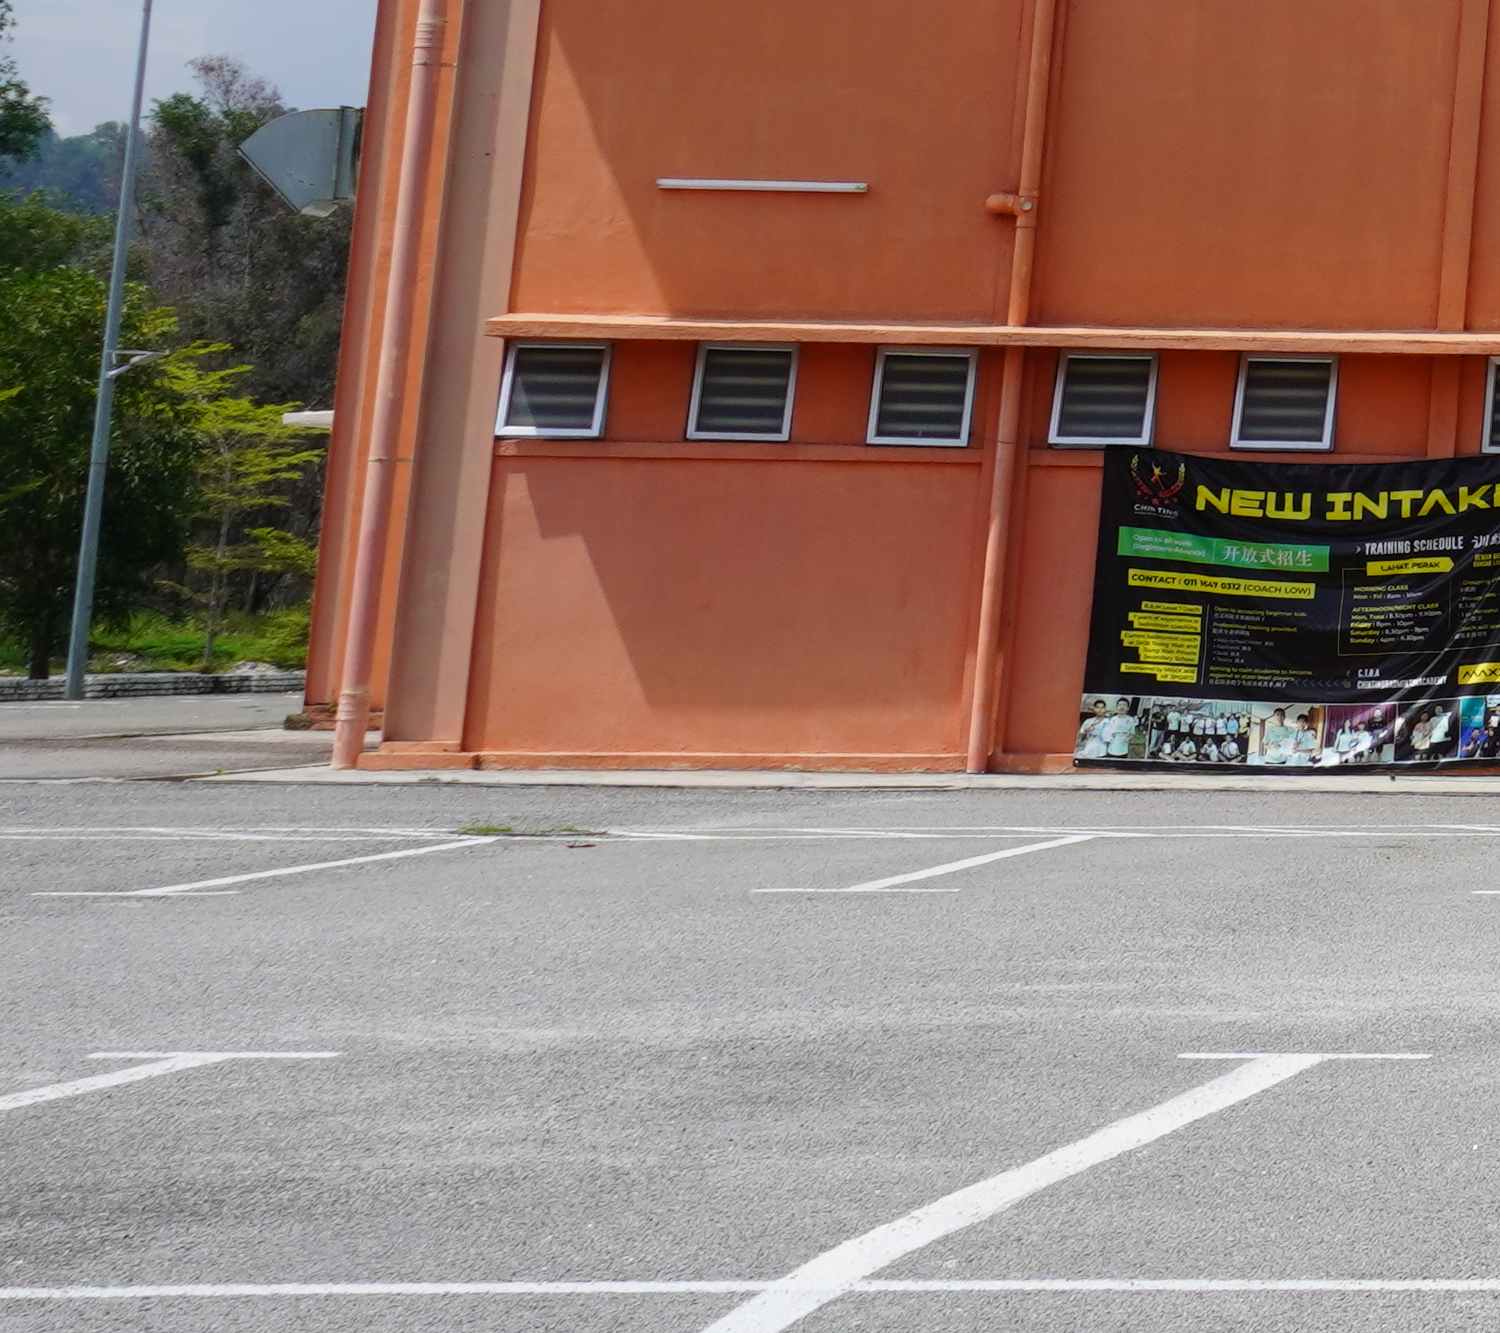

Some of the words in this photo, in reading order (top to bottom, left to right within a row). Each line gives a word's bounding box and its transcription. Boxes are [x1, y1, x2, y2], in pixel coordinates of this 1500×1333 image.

[1133, 503, 1156, 512] CHIN
[1157, 506, 1179, 517] TING
[1195, 485, 1312, 521] NEW
[1133, 533, 1153, 543] Open
[1365, 540, 1411, 556] TRAINING
[1413, 536, 1465, 553] SCHEDULE
[1223, 545, 1313, 568] 开放式招生
[1411, 561, 1441, 570] PERAK
[1131, 573, 1175, 585] CONTACT
[1184, 578, 1198, 587] 011
[1220, 582, 1241, 591] 0312
[1243, 583, 1282, 595] (COACH
[1284, 585, 1311, 596] LOW)
[1417, 602, 1439, 610] CLASS
